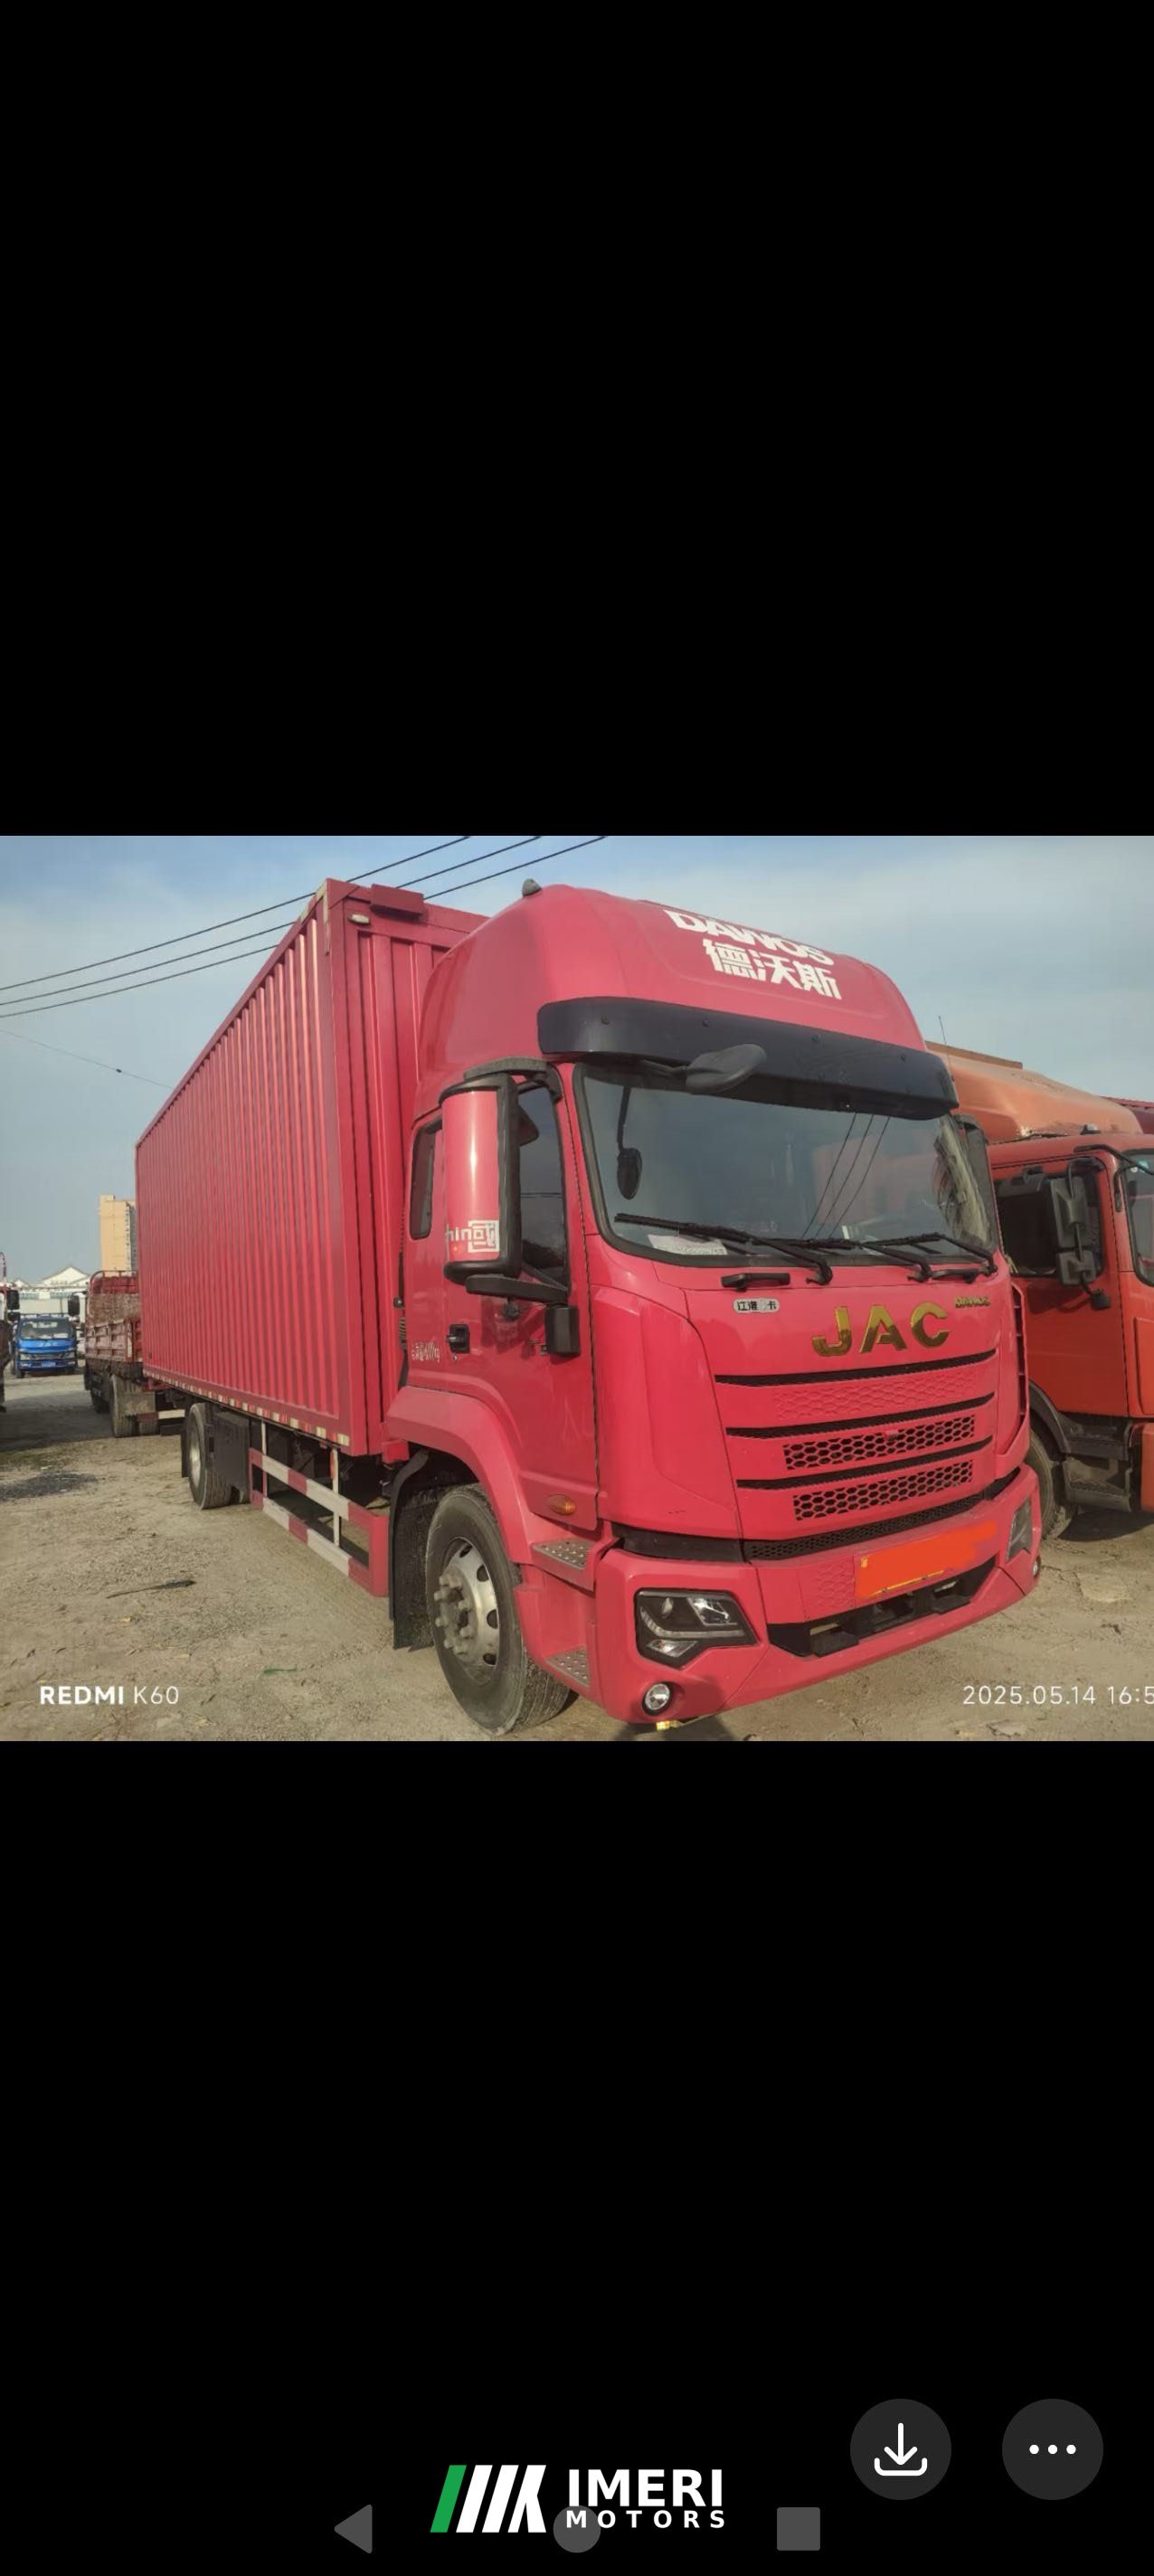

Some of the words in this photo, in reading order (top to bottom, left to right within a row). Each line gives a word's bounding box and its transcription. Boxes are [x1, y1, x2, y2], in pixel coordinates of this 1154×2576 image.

[663, 909, 834, 965] DAWOS
[703, 938, 842, 999] 德沃斯
[737, 1300, 778, 1311] 江淮卡
[811, 1302, 951, 1357] JAC
